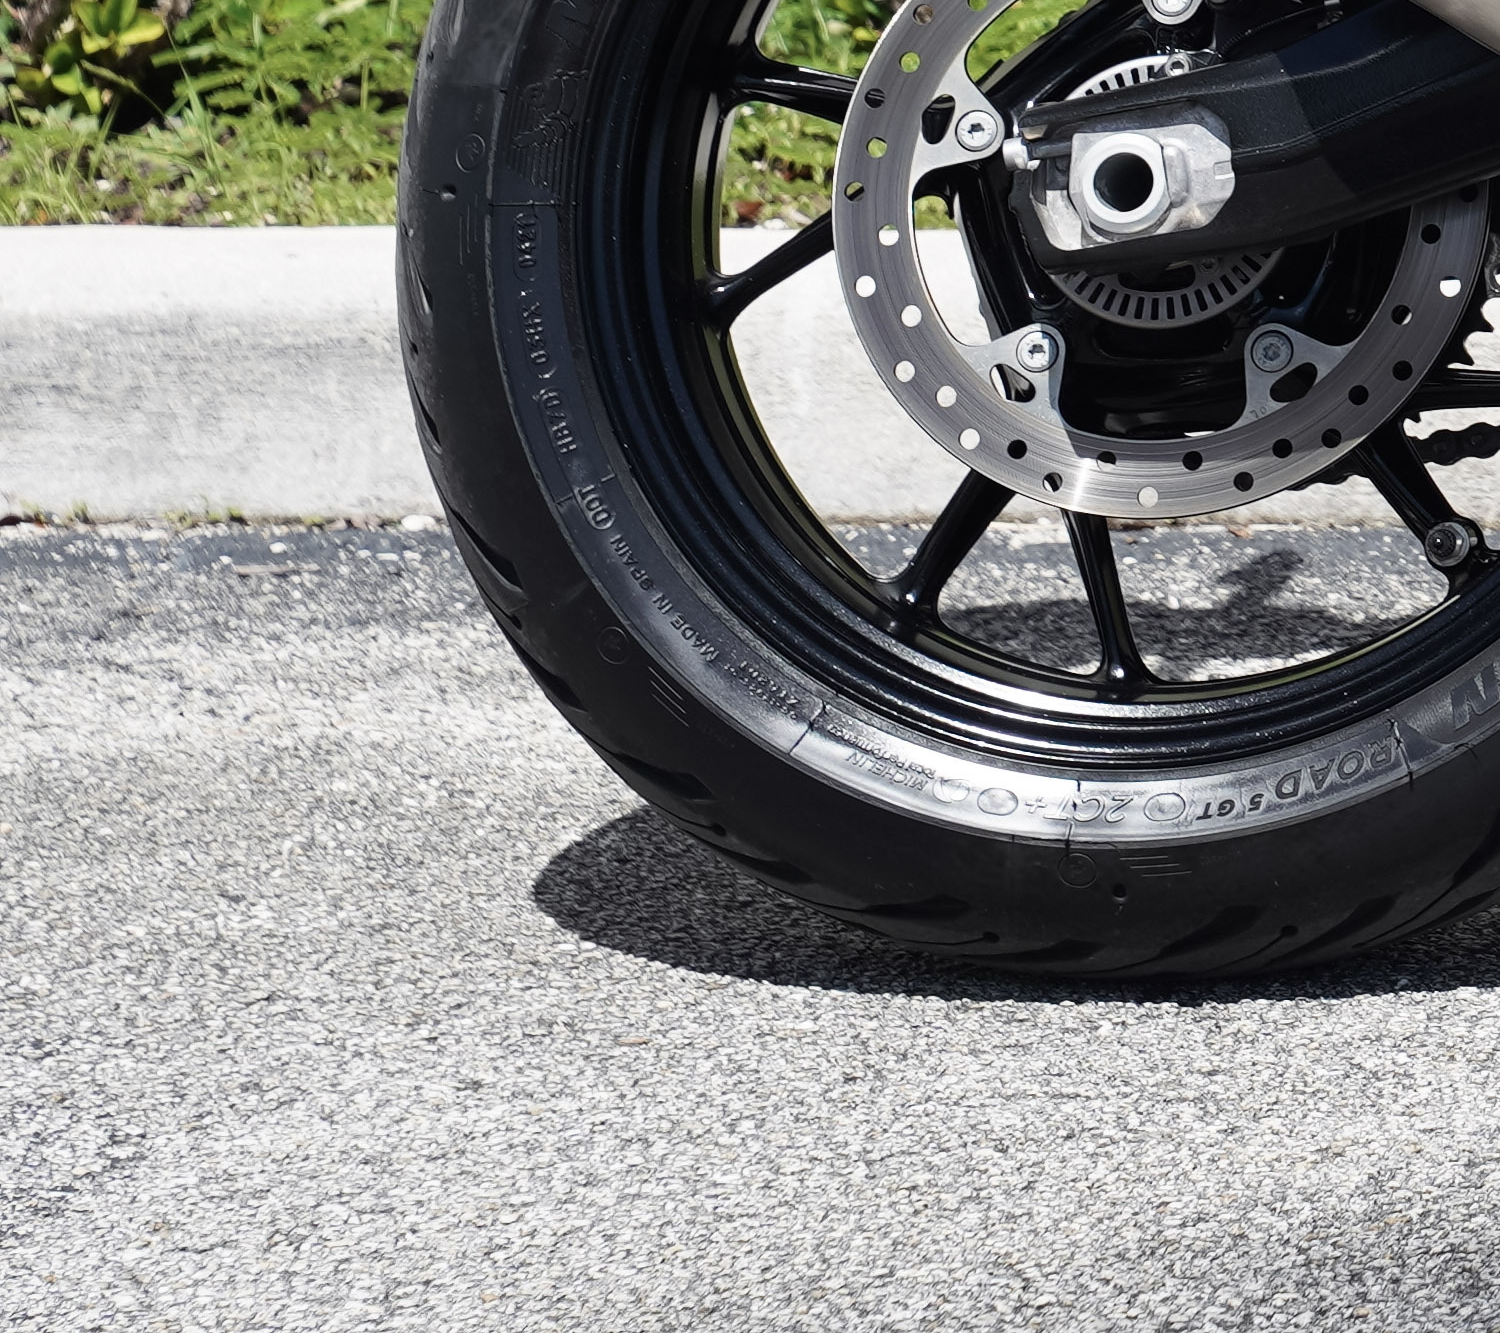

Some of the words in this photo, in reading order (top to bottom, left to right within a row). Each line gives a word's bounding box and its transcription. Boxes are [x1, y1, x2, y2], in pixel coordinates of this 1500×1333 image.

[576, 480, 613, 527] DOT
[608, 533, 657, 595] SPAIN
[649, 592, 675, 619] IN
[667, 612, 722, 666] MADE
[843, 747, 929, 793] MICHELIN
[1270, 735, 1399, 802] ROAD
[1193, 797, 1237, 819] GT
[1245, 792, 1268, 811] 5
